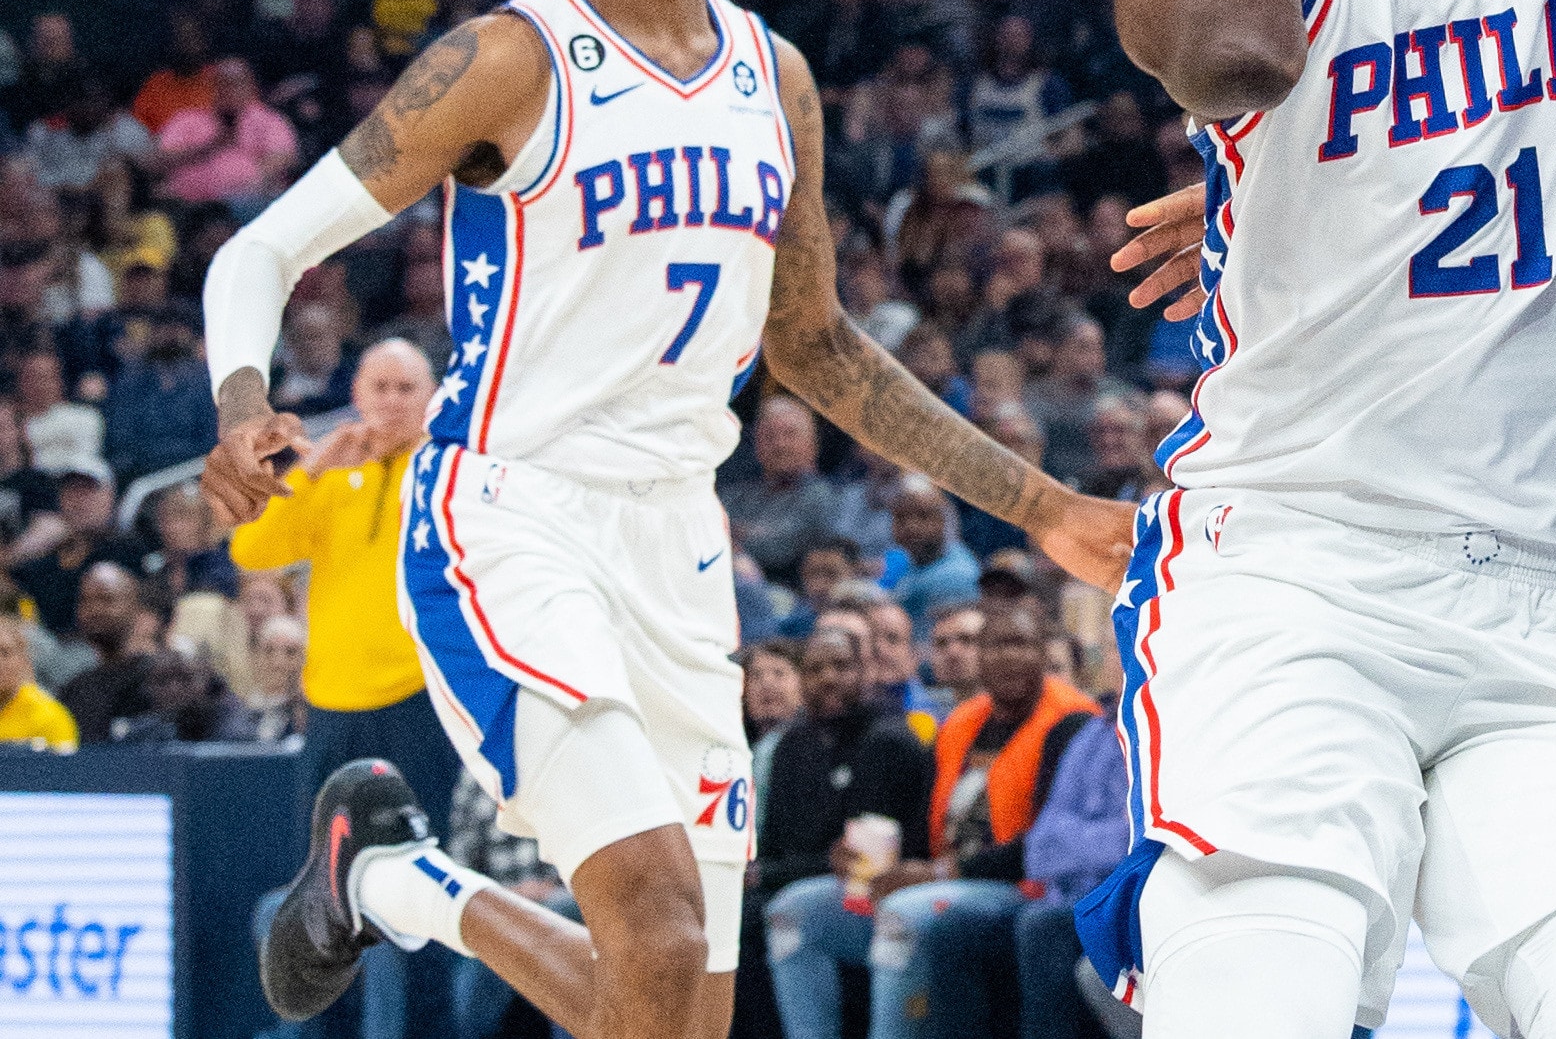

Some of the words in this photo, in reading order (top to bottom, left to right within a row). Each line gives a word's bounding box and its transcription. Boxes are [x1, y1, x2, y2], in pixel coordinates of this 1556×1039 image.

[571, 36, 602, 70] 6
[574, 145, 786, 252] PHILA
[1408, 146, 1554, 300] 21
[658, 263, 722, 365] 7
[694, 775, 747, 831] 76
[0, 903, 143, 998] ster
